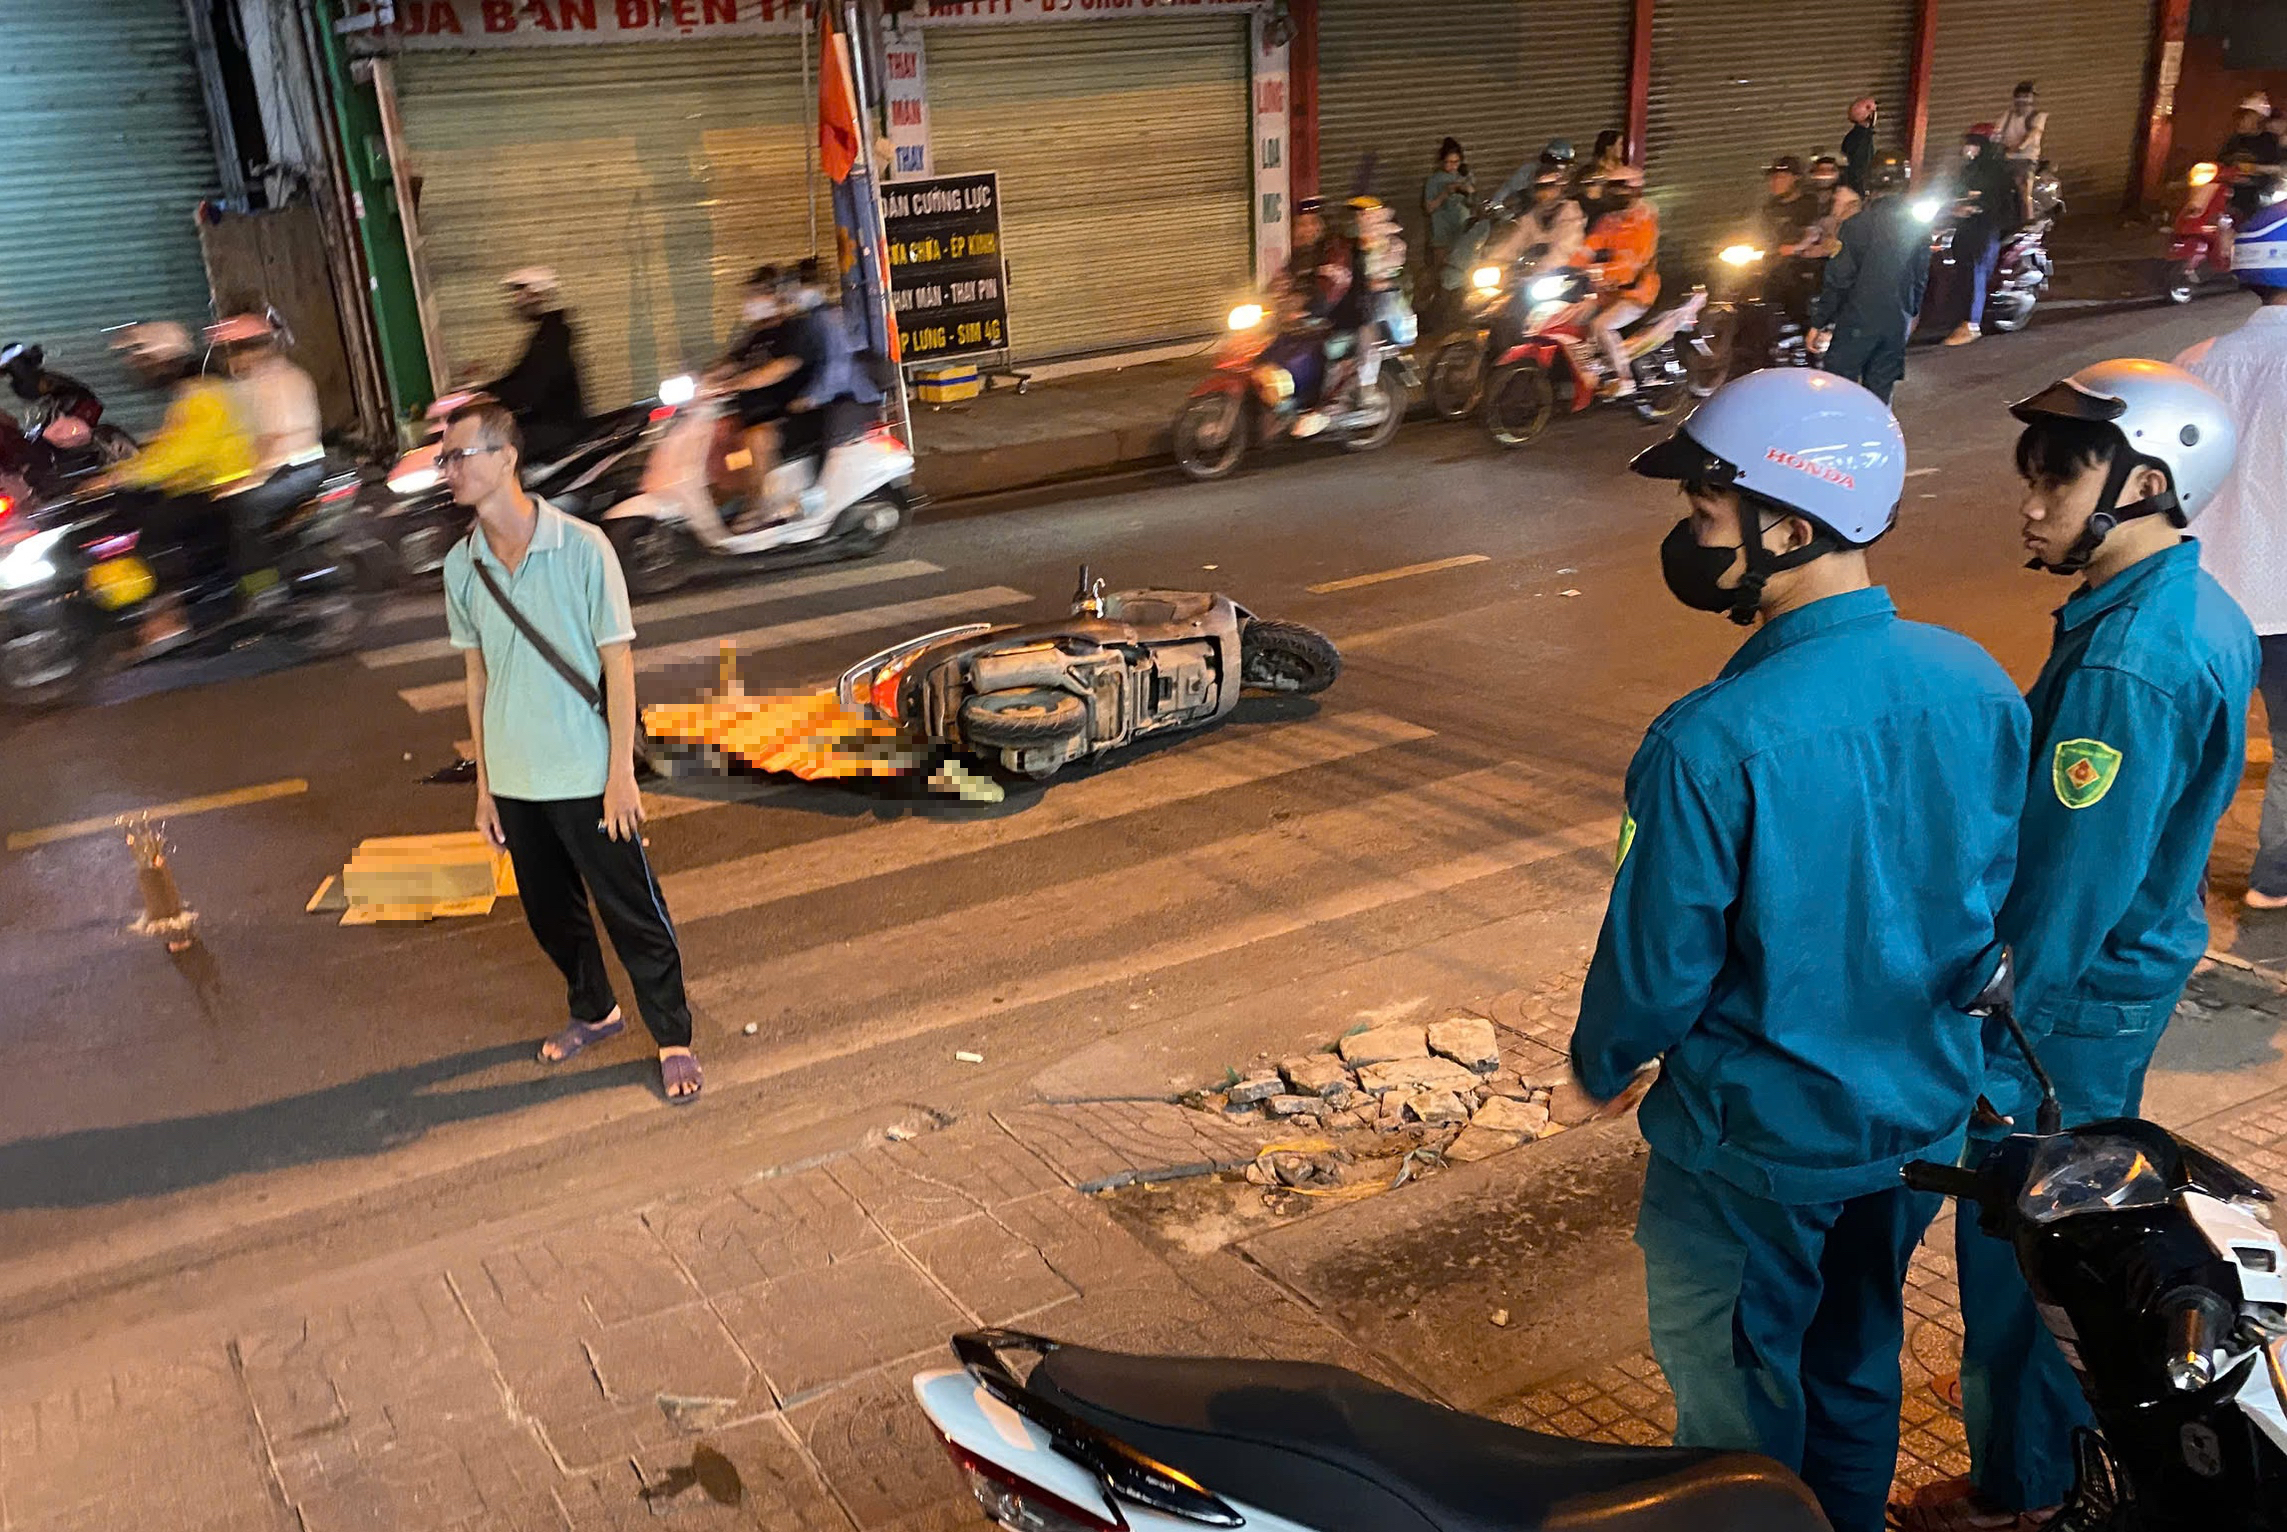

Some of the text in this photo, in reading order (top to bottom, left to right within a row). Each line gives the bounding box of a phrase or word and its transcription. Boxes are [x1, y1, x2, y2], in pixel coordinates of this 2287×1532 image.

[950, 280, 975, 304] THAY
[957, 321, 981, 345] SIM
[985, 319, 1001, 340] 4G
[1766, 447, 1856, 489] HONDA
